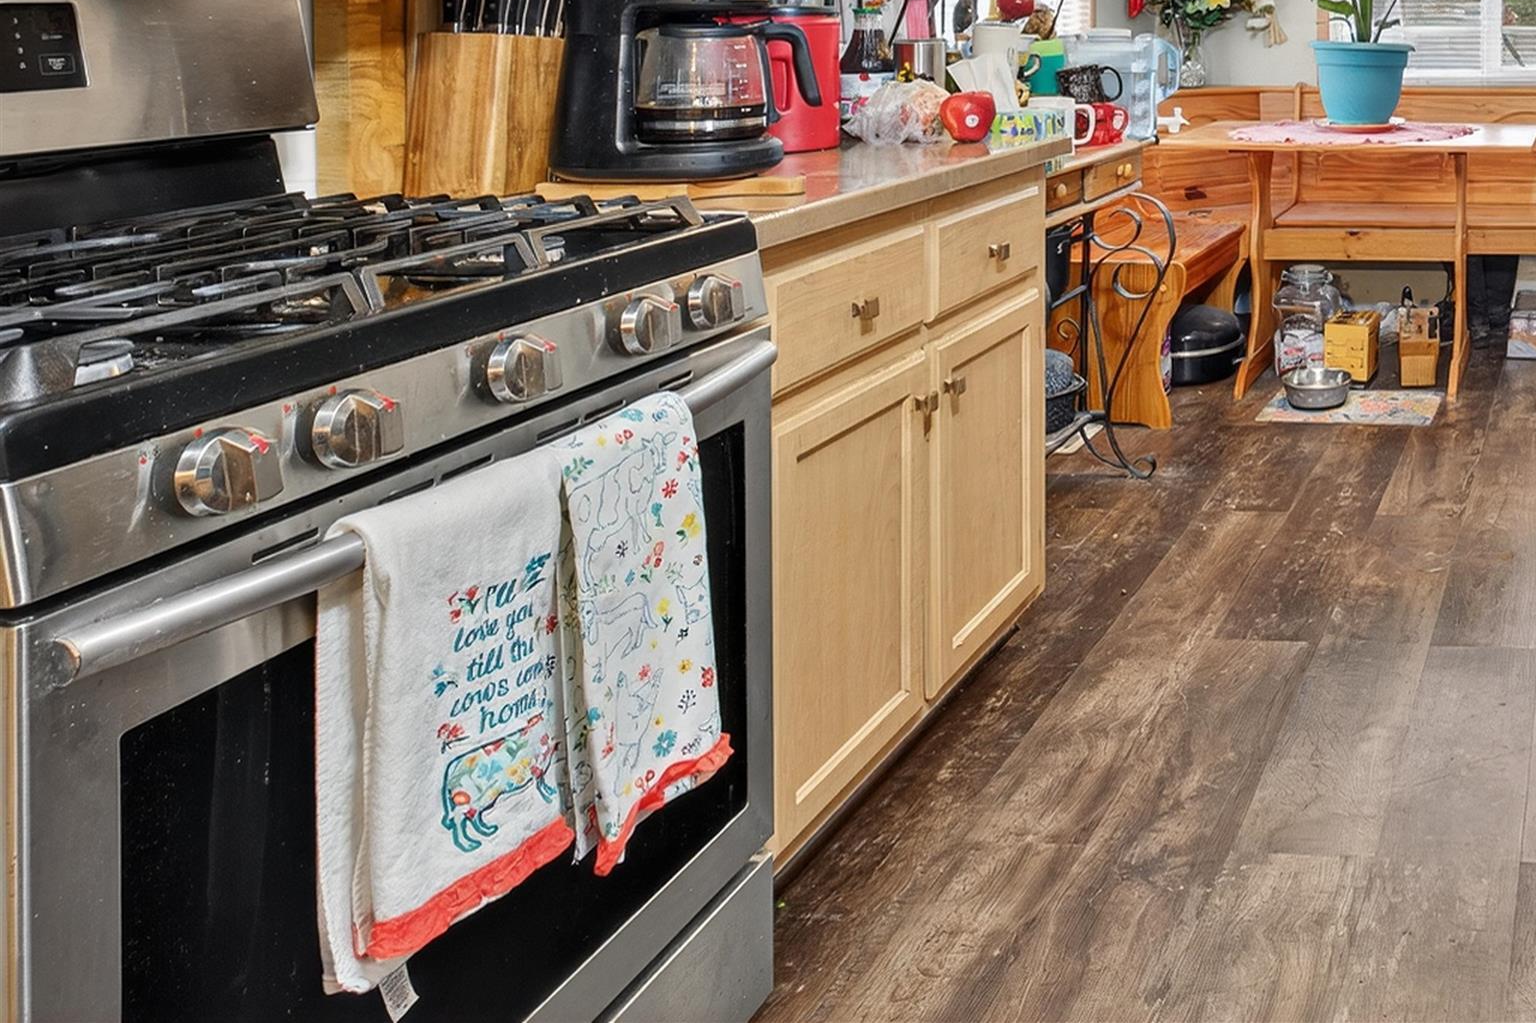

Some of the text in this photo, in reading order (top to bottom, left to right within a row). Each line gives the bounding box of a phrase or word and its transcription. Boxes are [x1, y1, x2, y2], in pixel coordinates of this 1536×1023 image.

[453, 618, 499, 652] love
[466, 635, 535, 682] till th
[450, 678, 508, 718] cows
